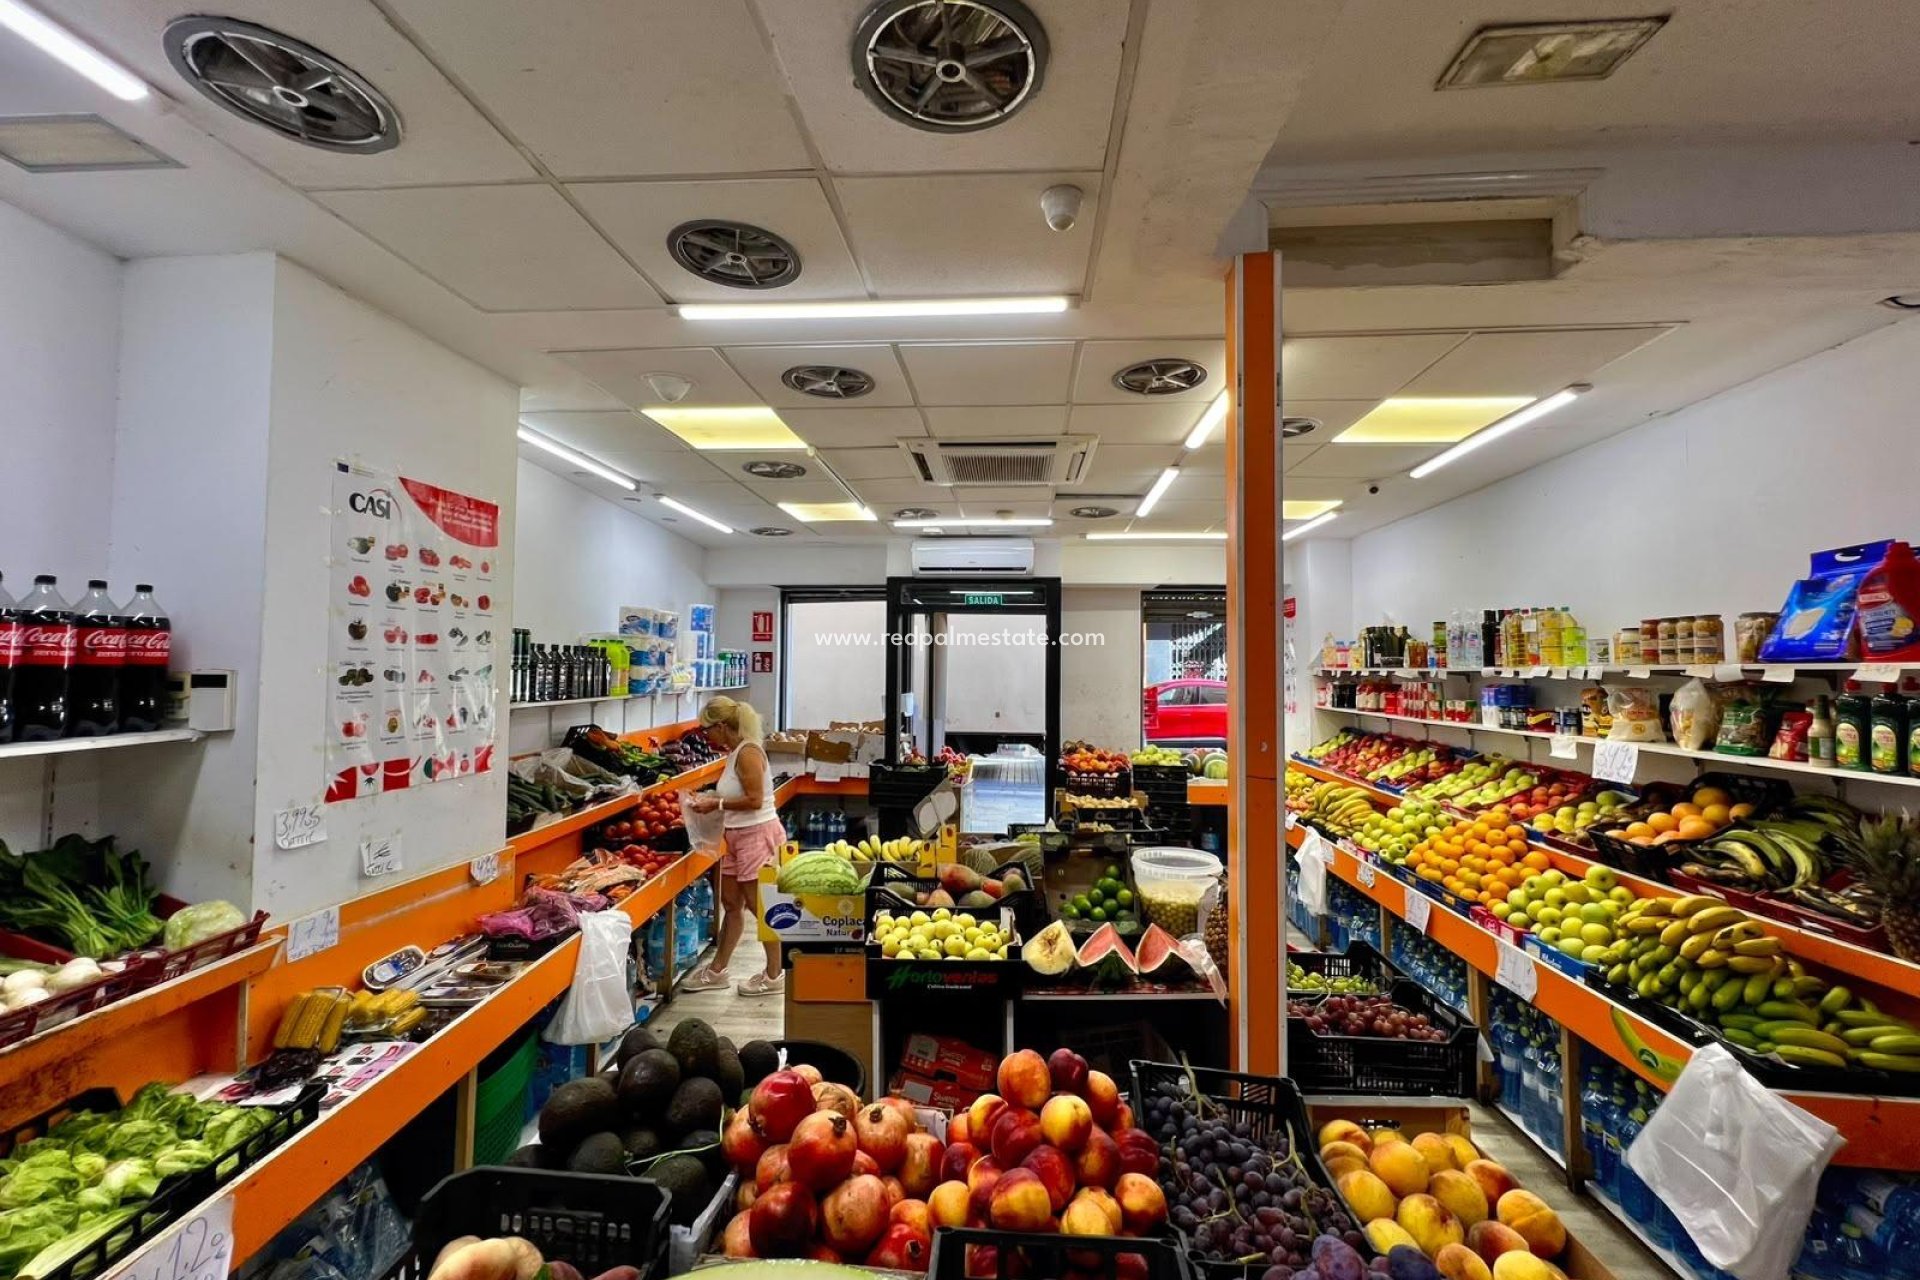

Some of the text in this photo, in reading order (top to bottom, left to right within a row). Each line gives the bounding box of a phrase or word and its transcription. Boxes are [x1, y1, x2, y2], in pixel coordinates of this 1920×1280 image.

[349, 492, 391, 519] CASI
[968, 596, 999, 605] SALIDA
[822, 915, 865, 928] Coplac
